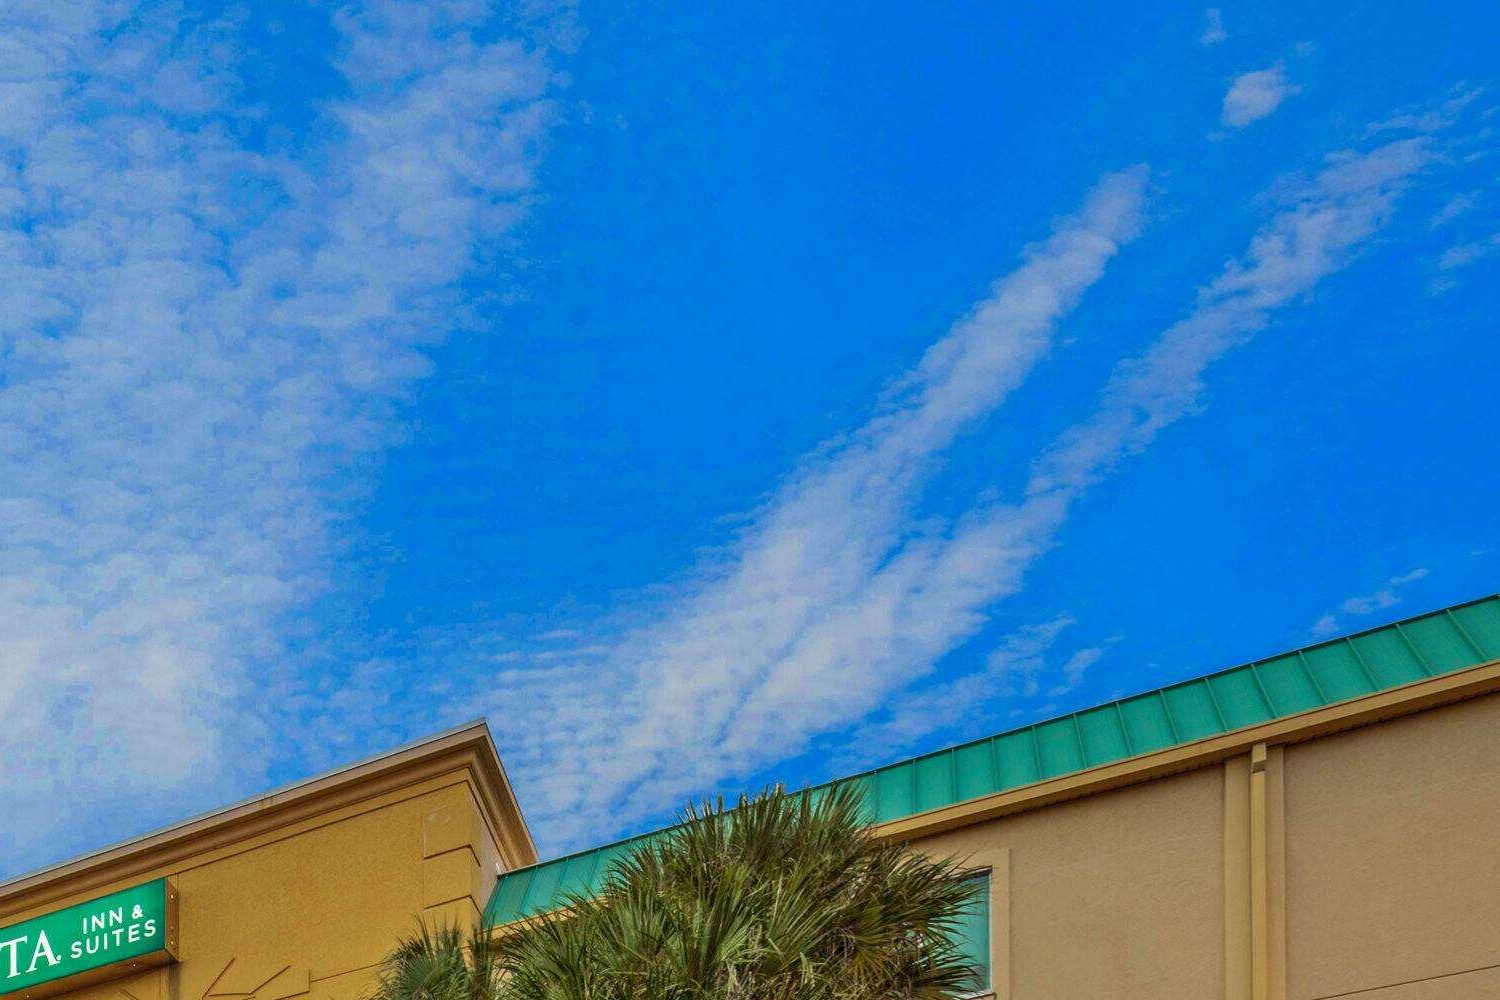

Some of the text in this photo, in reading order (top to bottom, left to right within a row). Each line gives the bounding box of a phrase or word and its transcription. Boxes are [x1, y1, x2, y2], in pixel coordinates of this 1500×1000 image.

[83, 904, 144, 935] INN &
[70, 918, 156, 959] SUITES
